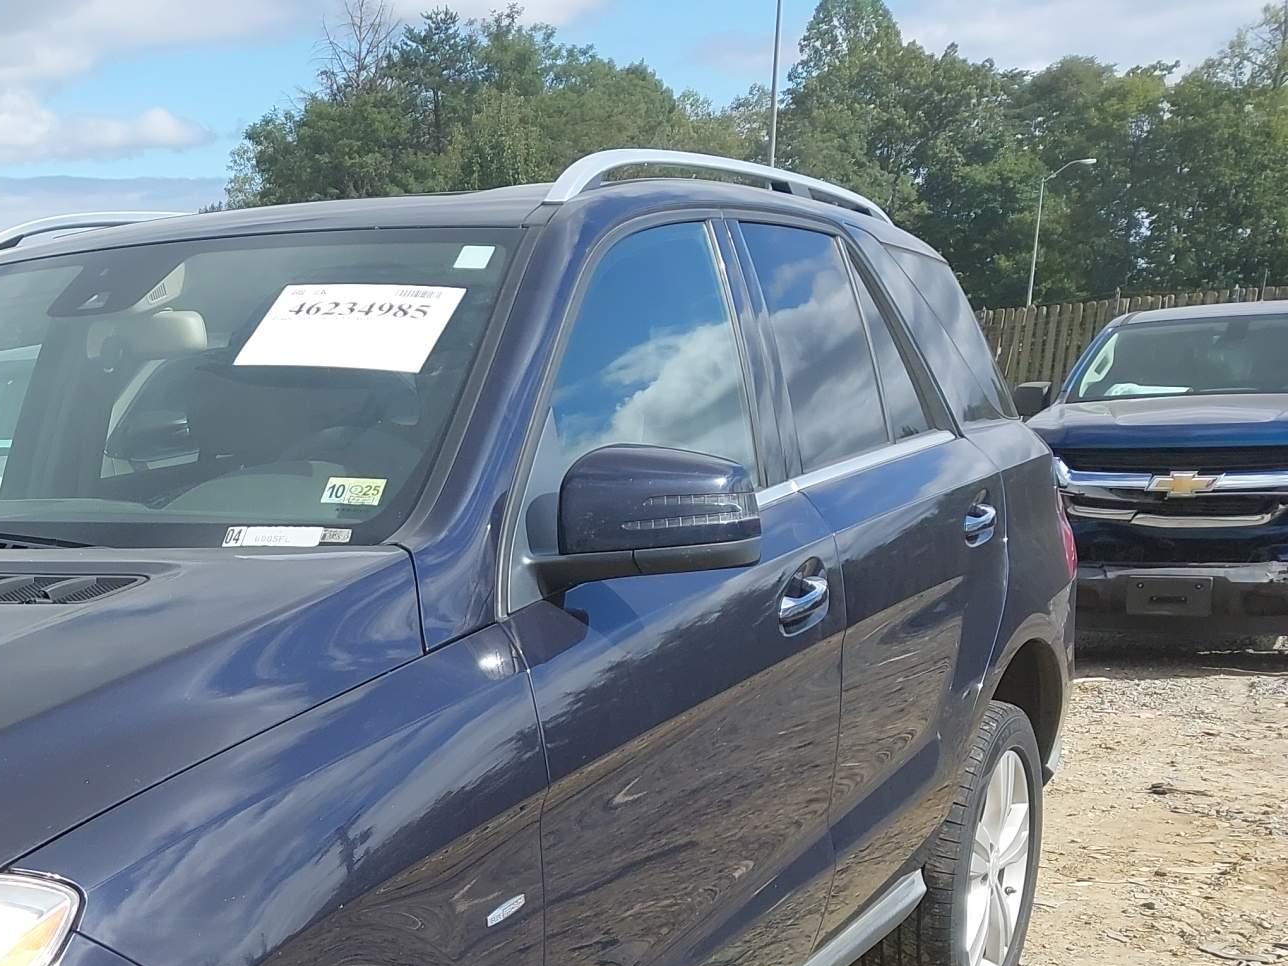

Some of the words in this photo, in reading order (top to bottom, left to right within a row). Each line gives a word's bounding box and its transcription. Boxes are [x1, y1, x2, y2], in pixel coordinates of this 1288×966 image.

[289, 301, 432, 319] 46234985
[327, 483, 346, 499] 10
[362, 484, 382, 498] 25
[225, 528, 243, 544] 04
